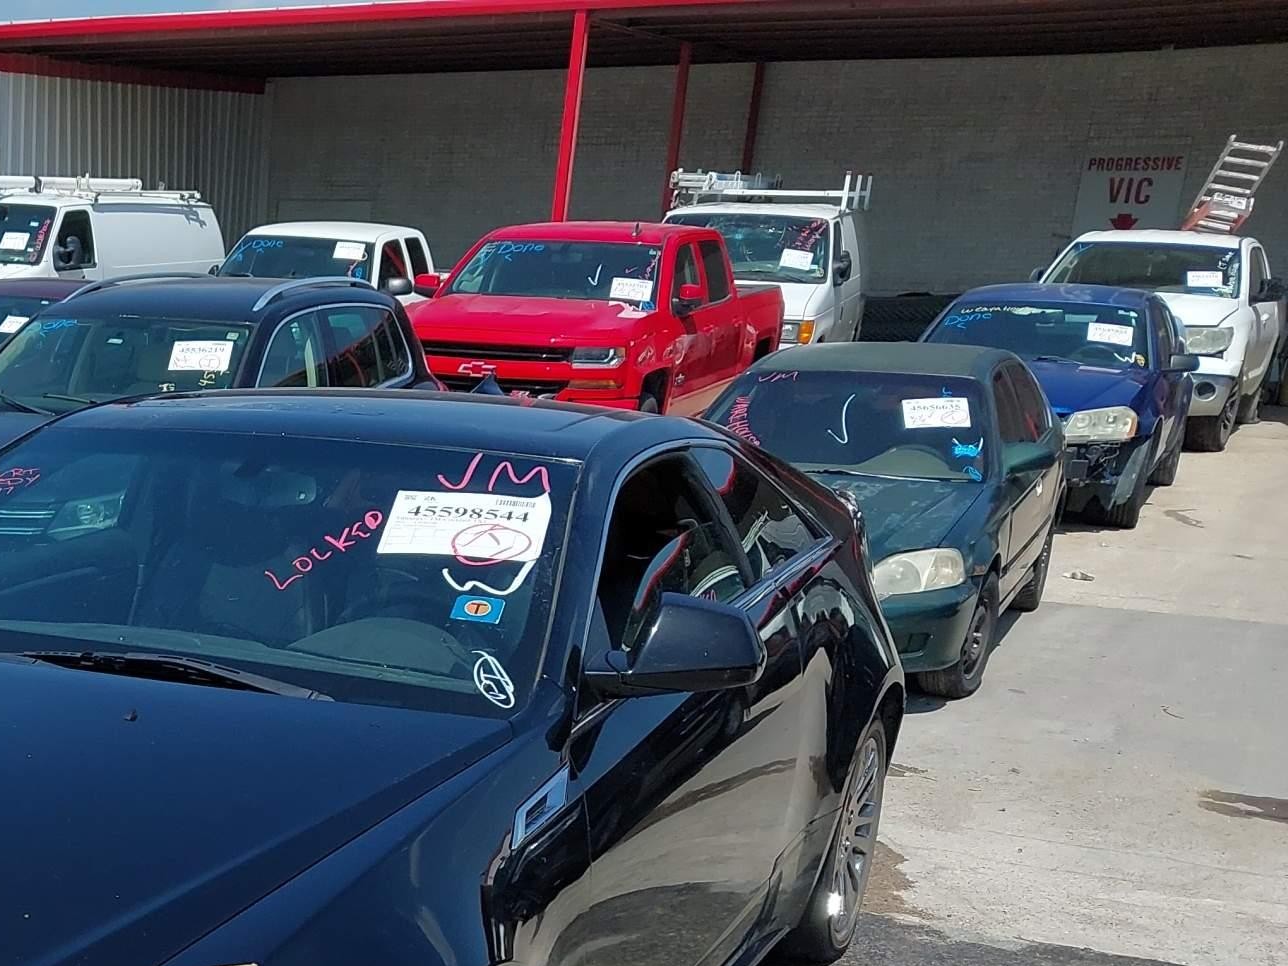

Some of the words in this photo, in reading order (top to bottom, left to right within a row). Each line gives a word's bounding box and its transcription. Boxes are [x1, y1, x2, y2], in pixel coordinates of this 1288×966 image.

[1087, 156, 1184, 172] PROGRESSIVE
[1108, 177, 1154, 205] VIC
[407, 504, 531, 523] 45598544
